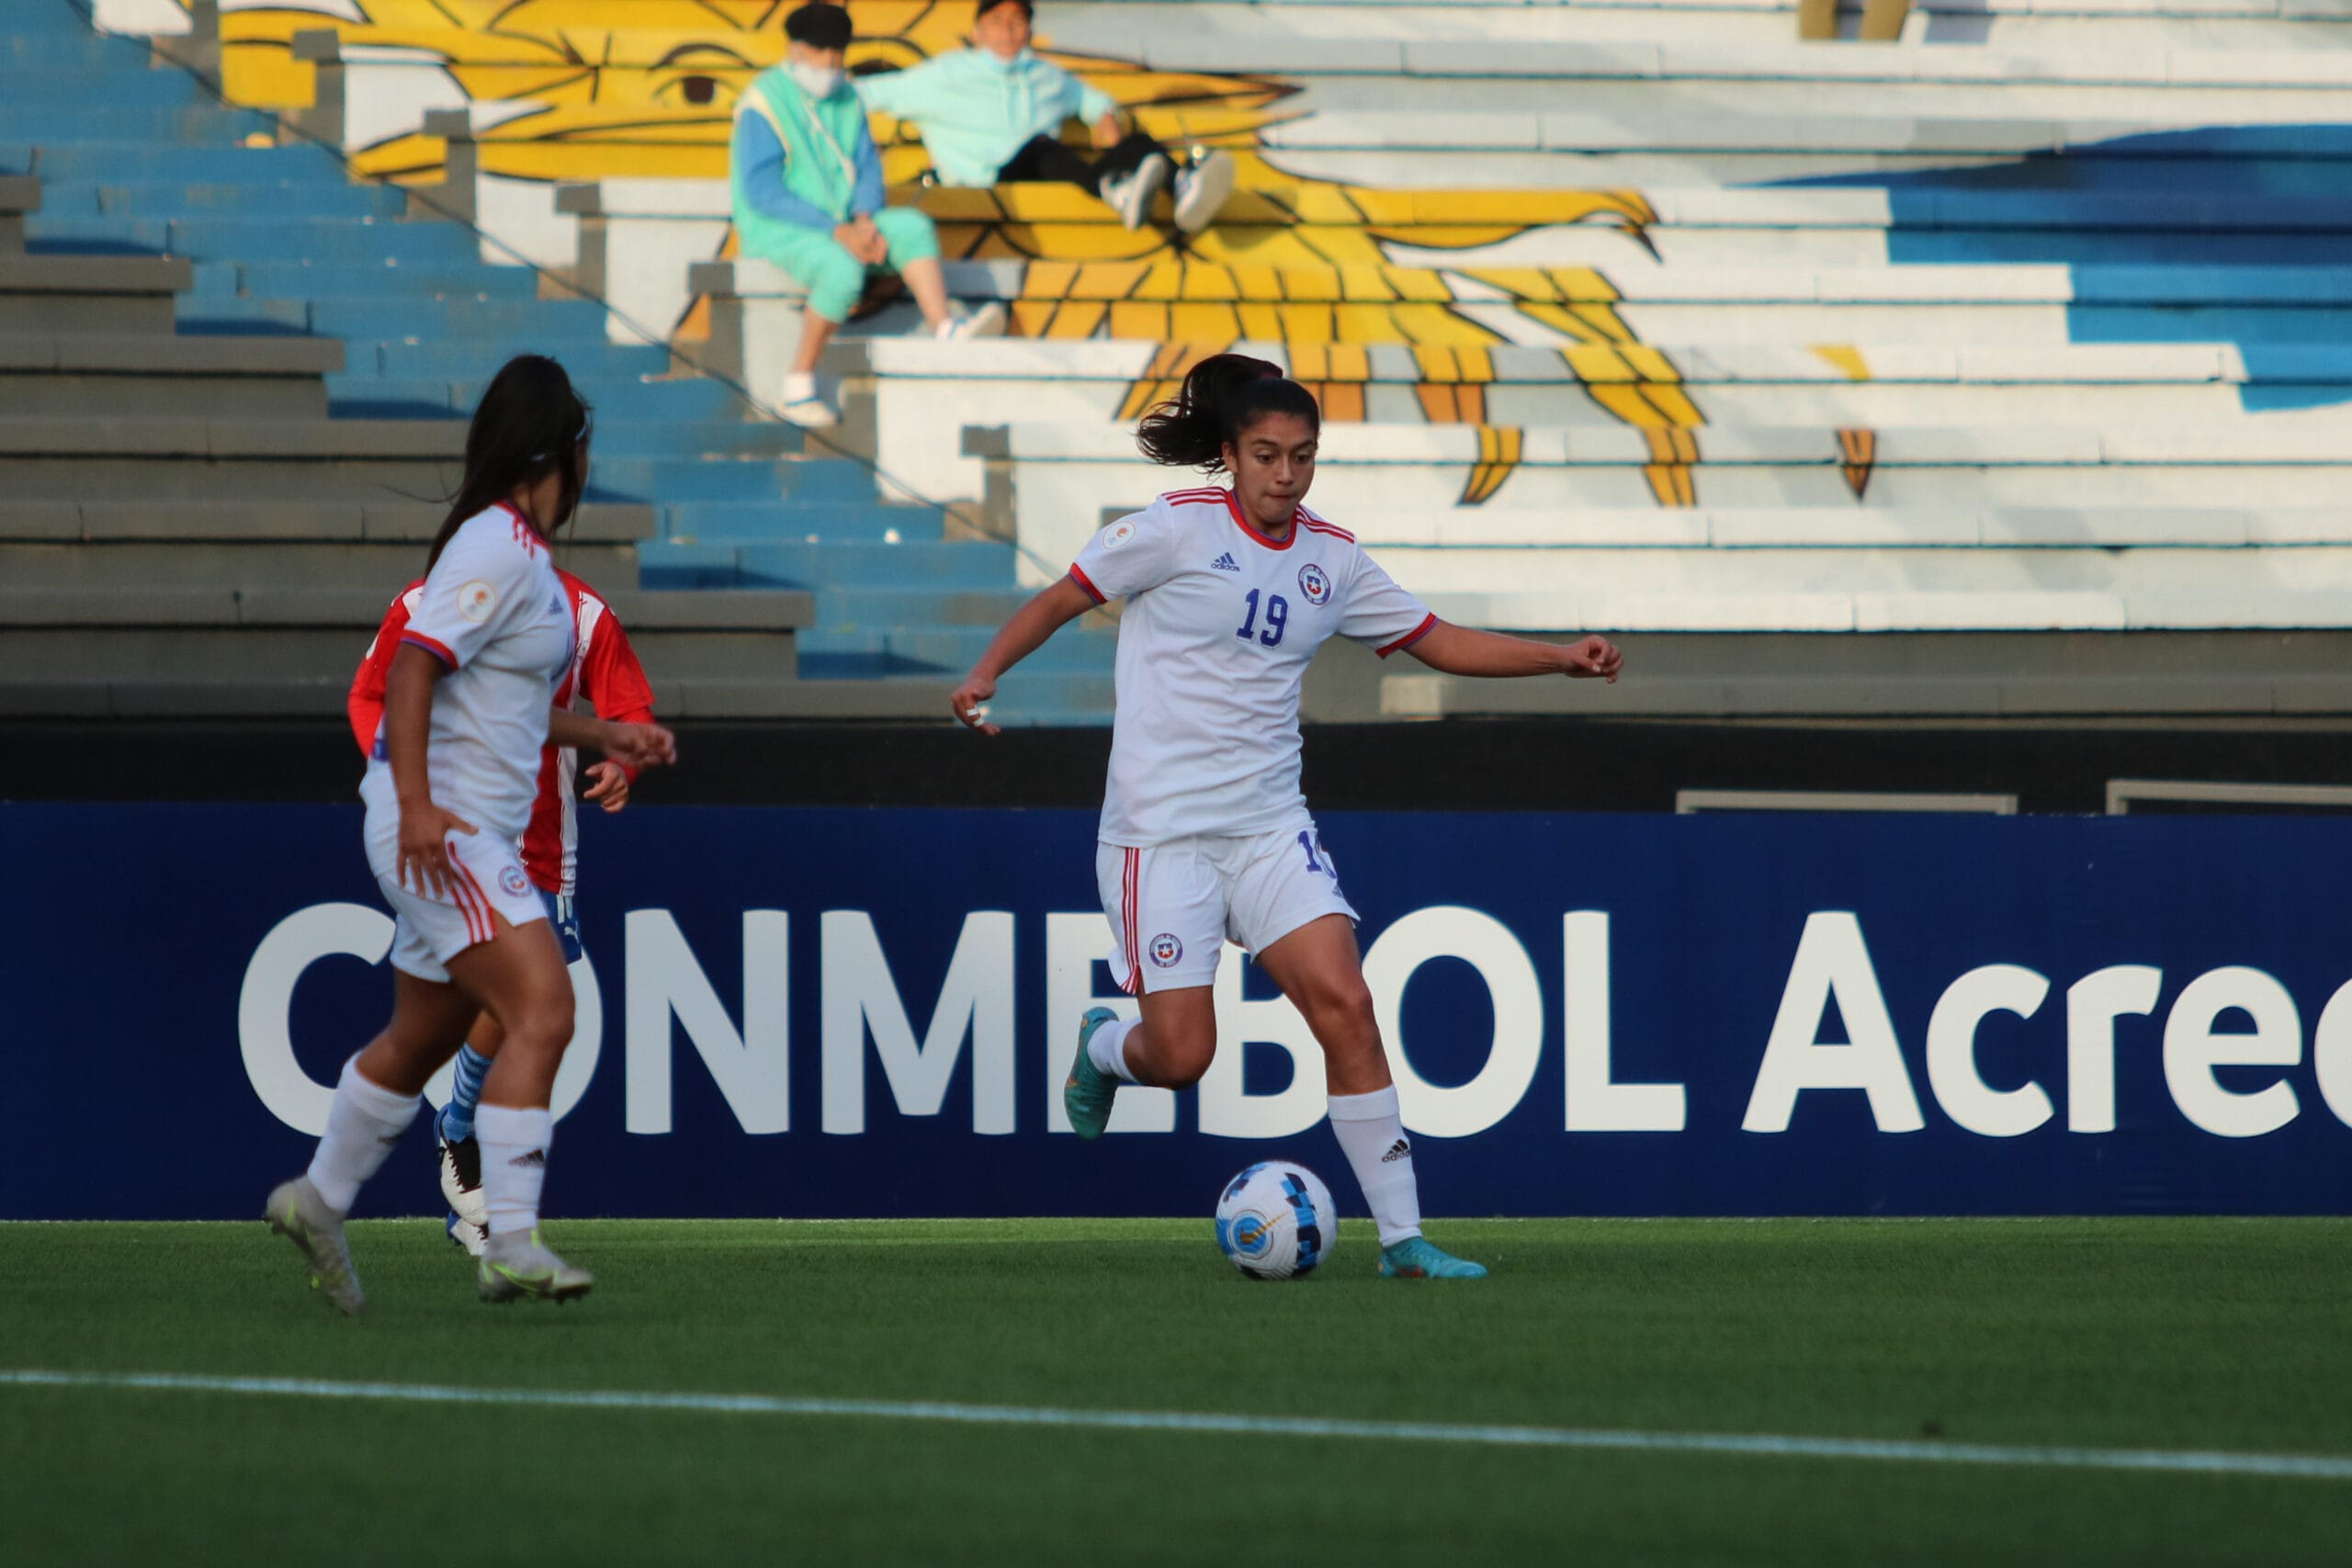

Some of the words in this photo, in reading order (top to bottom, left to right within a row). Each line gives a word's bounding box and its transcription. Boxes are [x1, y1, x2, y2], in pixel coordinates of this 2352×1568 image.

[1211, 562, 1240, 571] adidas
[1236, 588, 1288, 647] 19
[1297, 829, 1338, 880] 1
[1742, 911, 2352, 1138] Acre
